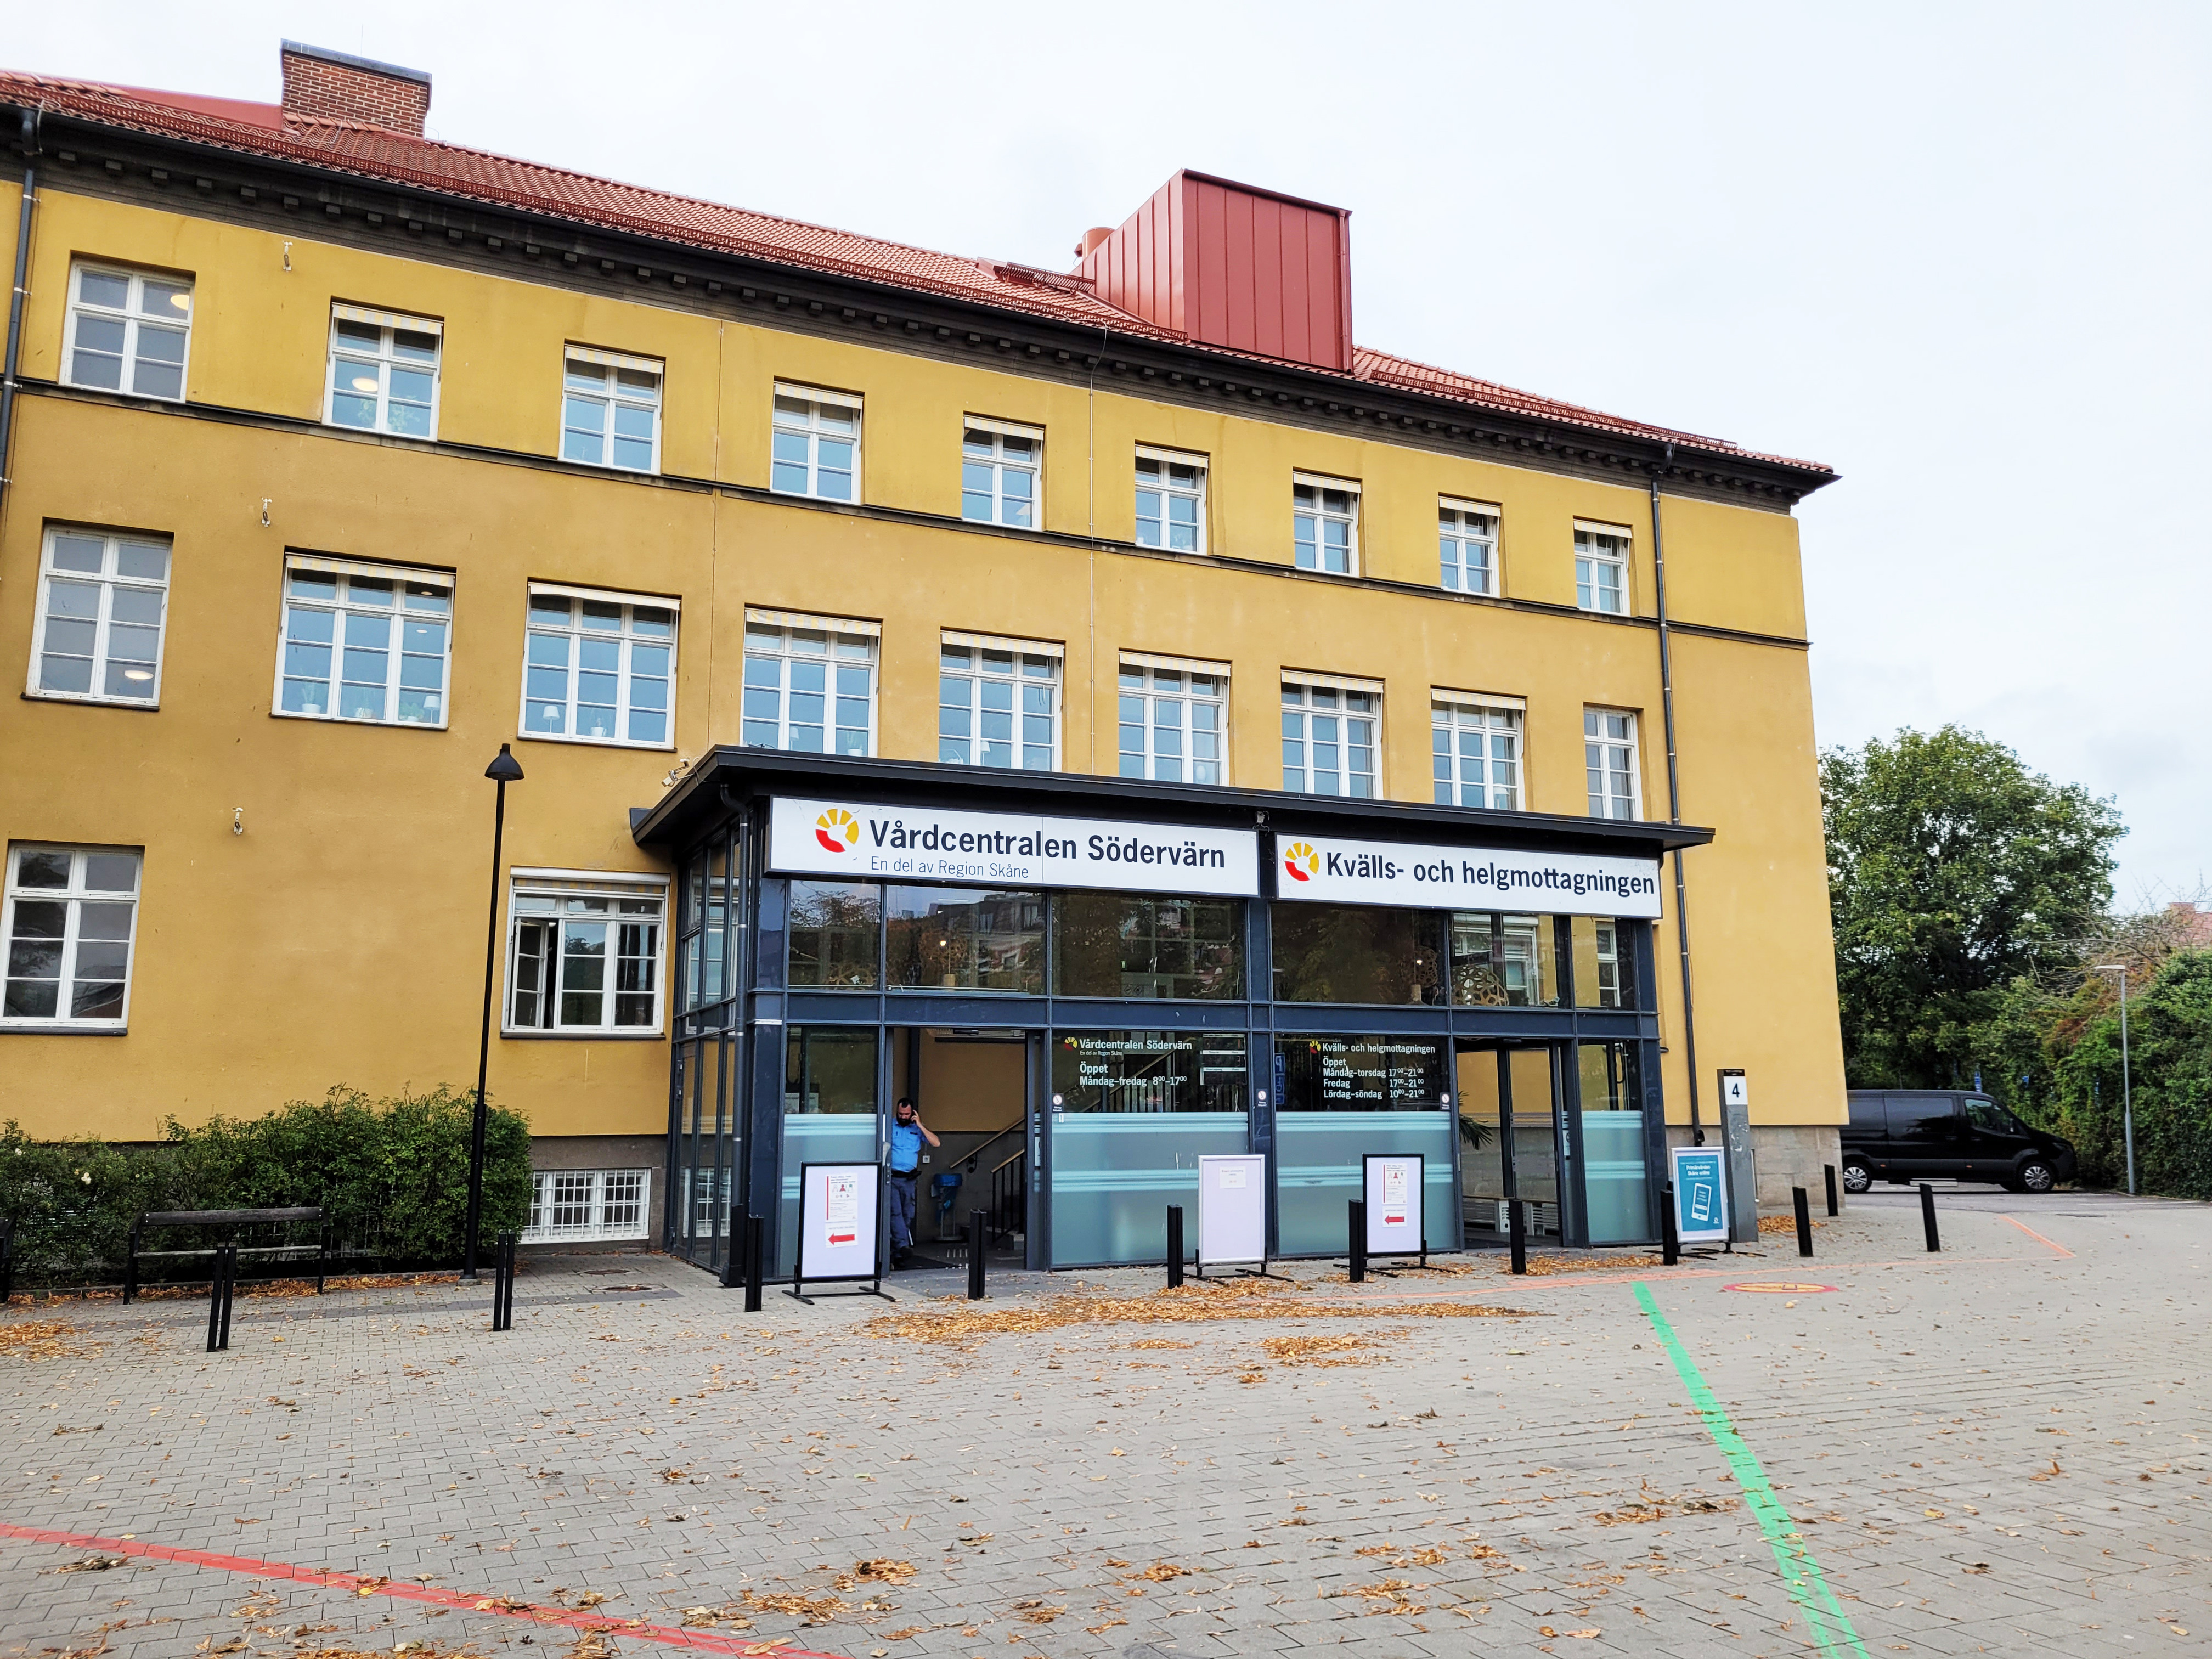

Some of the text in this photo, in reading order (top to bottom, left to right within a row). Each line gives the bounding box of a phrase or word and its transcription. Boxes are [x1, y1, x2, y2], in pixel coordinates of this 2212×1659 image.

[869, 819, 1225, 868] Vårdcentralen Södervärn
[871, 856, 1029, 878] En del av Region Skåne
[1327, 852, 1655, 898] Kvälls- och helgmottagningen
[1079, 1039, 1193, 1051] Vårdcentralen Södervärn
[1322, 1043, 1435, 1054] Kvälls- och helgmottagningen
[1079, 1060, 1108, 1075] Öppet
[1323, 1056, 1346, 1068] Öppet
[1323, 1068, 1386, 1078] Måndag–torsdag
[1079, 1075, 1147, 1087] Måndag–fredag
[1323, 1079, 1351, 1088] Fredag
[1323, 1089, 1383, 1099] Lördag–söndag
[1731, 1082, 1740, 1098] 4
